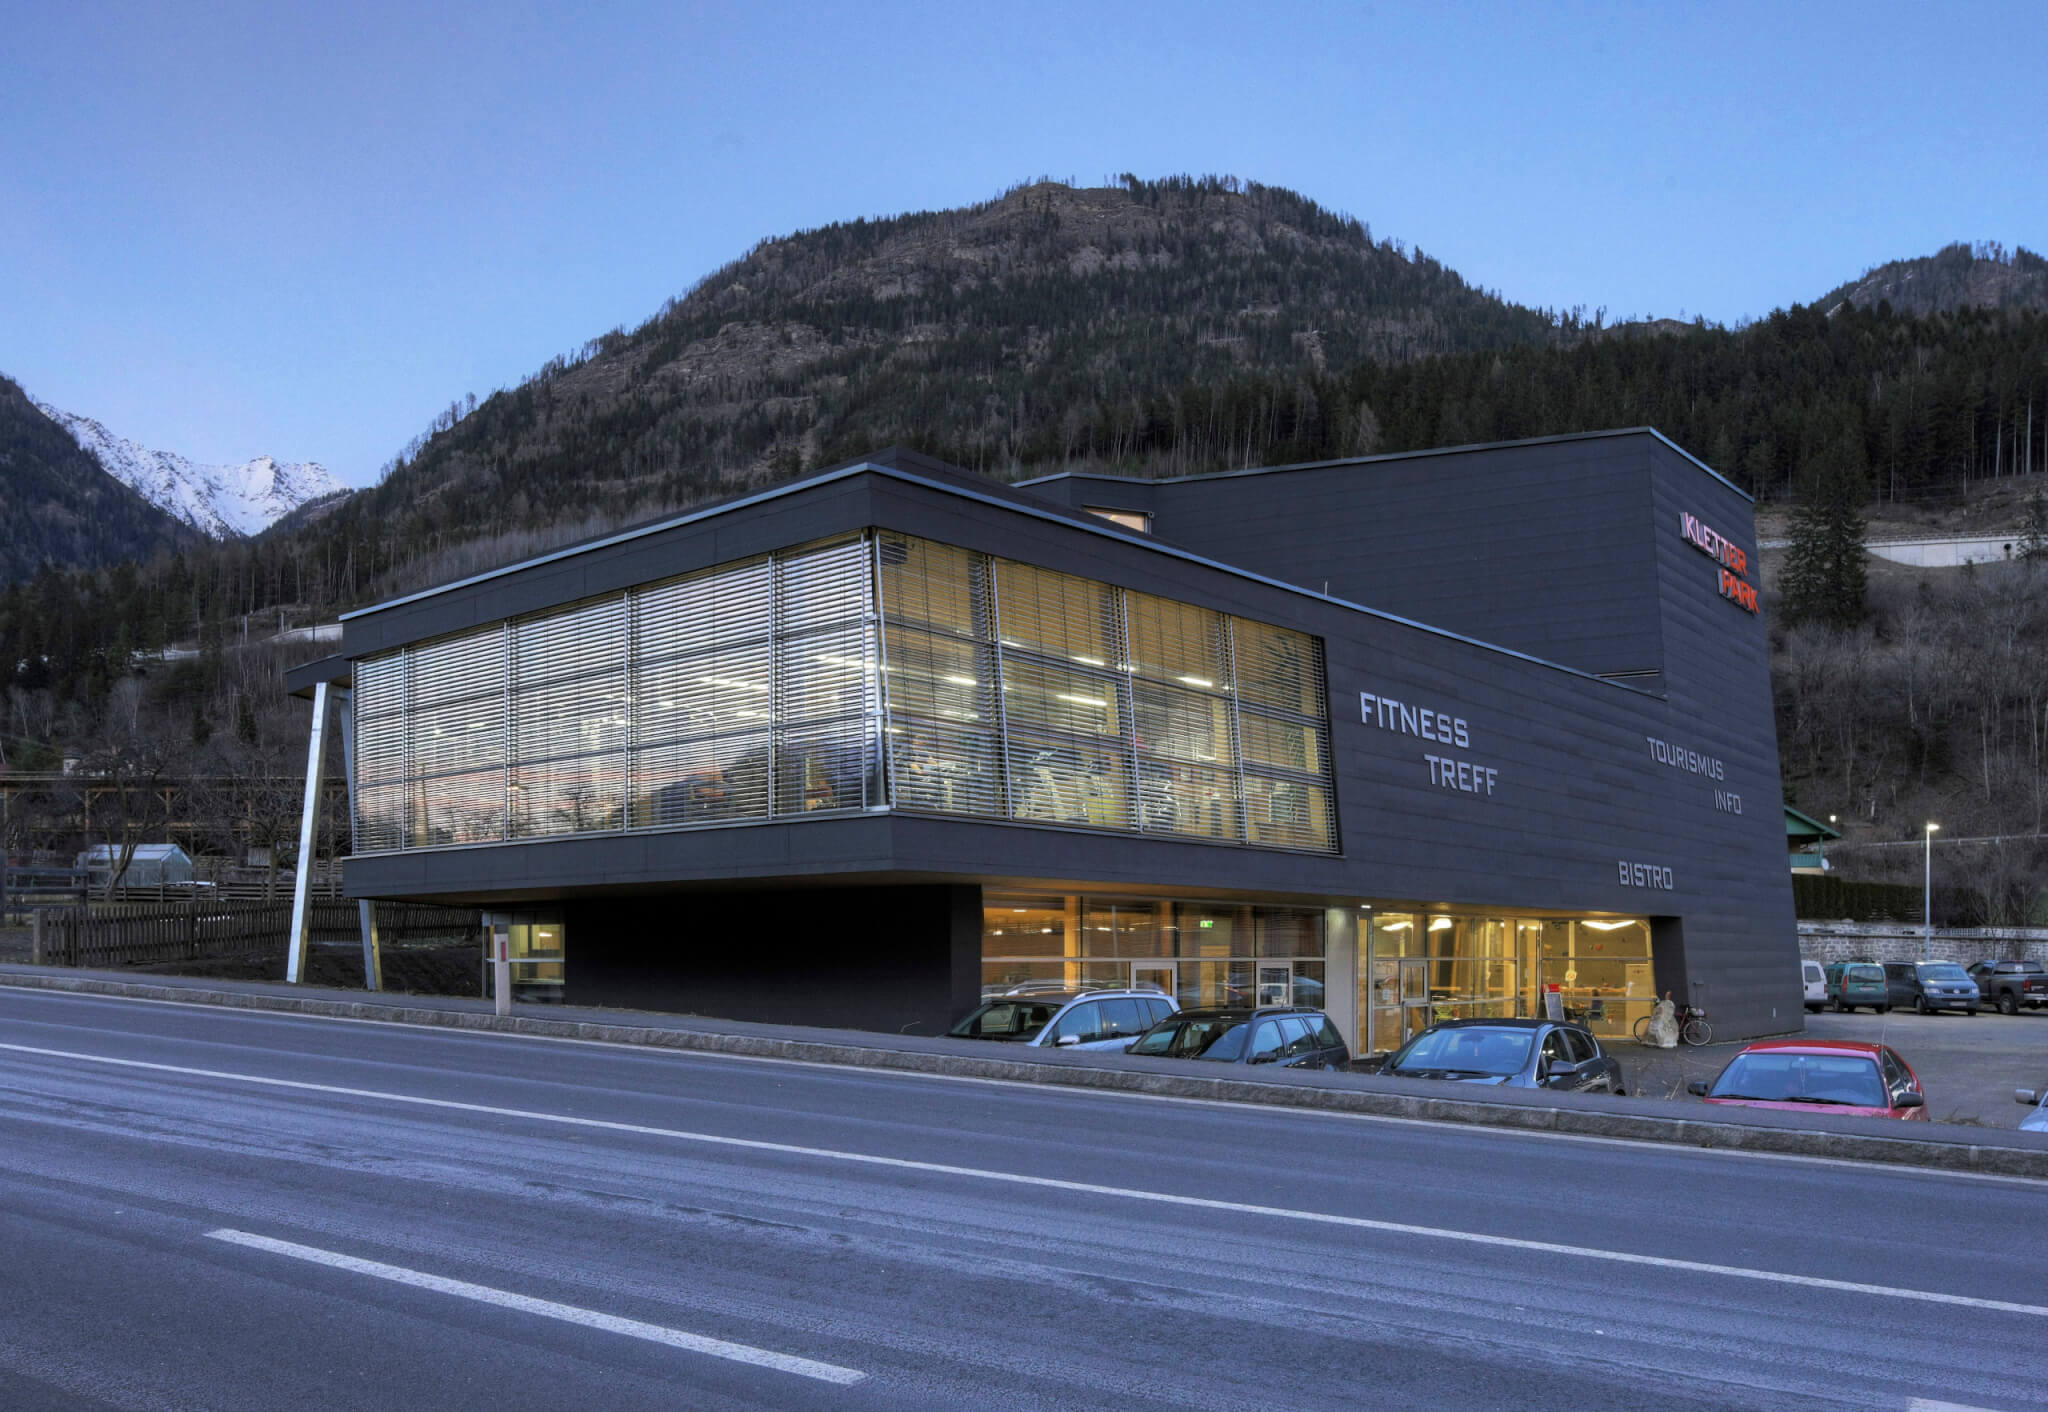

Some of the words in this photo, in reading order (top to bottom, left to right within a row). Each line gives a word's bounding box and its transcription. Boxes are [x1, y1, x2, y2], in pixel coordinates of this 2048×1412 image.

[1682, 511, 1748, 577] KLETTER
[1720, 568, 1760, 614] PARK
[1360, 691, 1470, 748] FITNESS
[1424, 753, 1498, 796] TREFF
[1646, 736, 1725, 781] TOURISMUS
[1713, 788, 1743, 815] INFO
[1618, 860, 1674, 890] BISTRO
